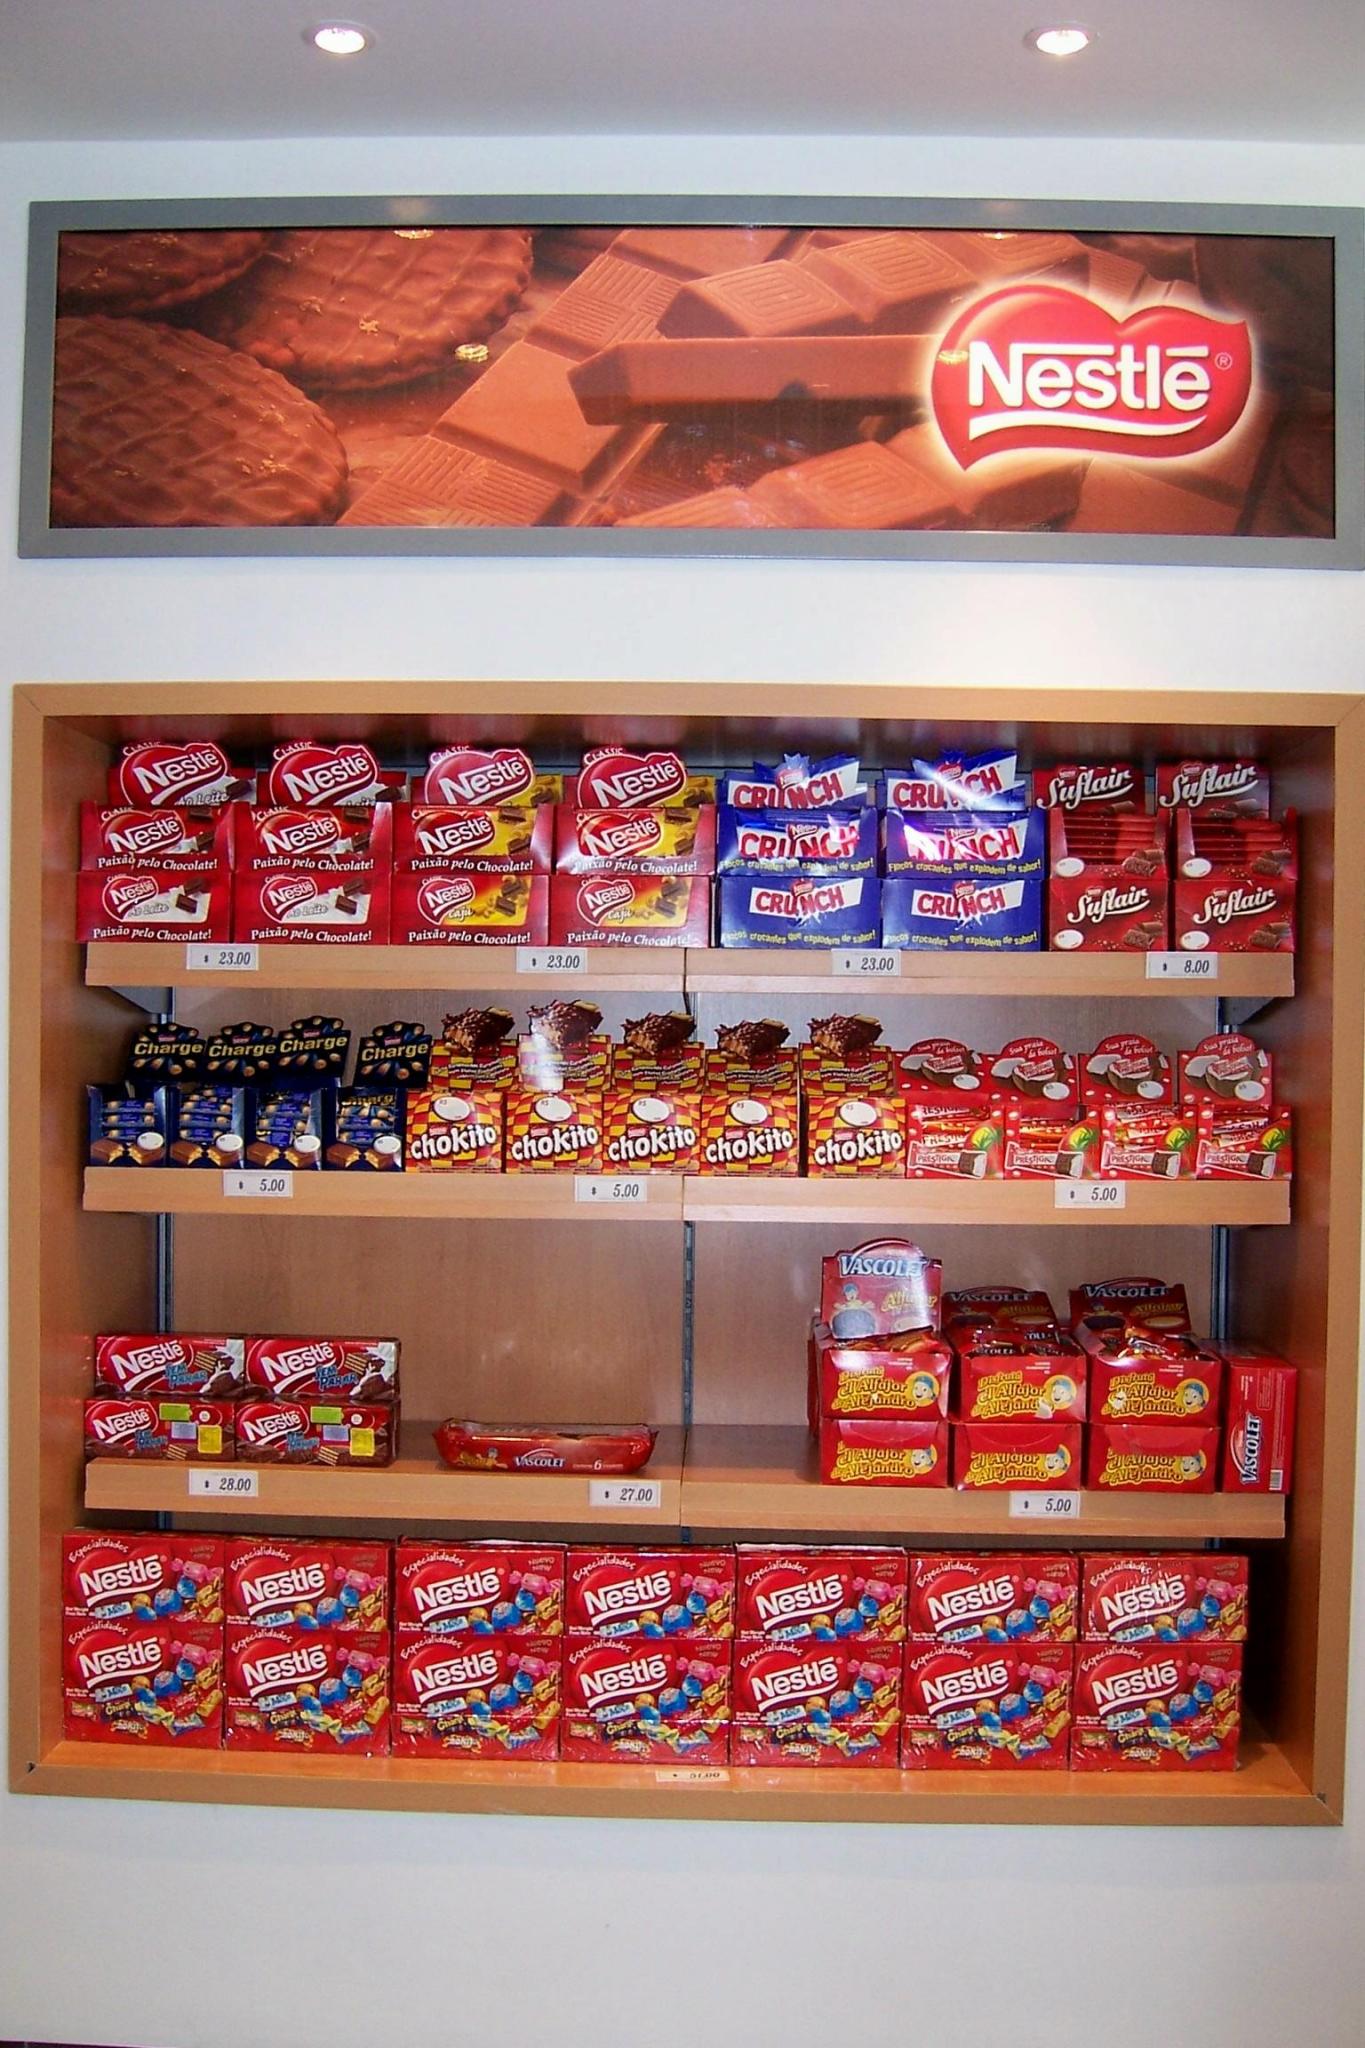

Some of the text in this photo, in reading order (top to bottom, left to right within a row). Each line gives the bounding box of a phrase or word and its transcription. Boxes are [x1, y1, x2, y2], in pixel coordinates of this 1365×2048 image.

[733, 772, 844, 809] CRUNCH
[893, 766, 1003, 809] CRUCH
[1037, 767, 1132, 811] Suflair
[1159, 764, 1258, 808] Suflair
[137, 856, 161, 869] pelo
[162, 859, 218, 871] Chocolate!
[292, 857, 316, 870] pelo
[317, 859, 374, 871] Chocolate!
[451, 860, 474, 870] pelo
[476, 860, 534, 873] Chocolate!
[614, 860, 638, 872] pelo
[755, 886, 844, 915] CRUNCH
[917, 888, 1006, 919] CRUNCH
[1067, 885, 1150, 923] Suflair
[1193, 886, 1275, 924] Suflair
[92, 925, 212, 941] Paixão pelo Chocolate!
[251, 926, 372, 943] Paixão pelo Chocolate!
[408, 929, 531, 945] Paixão pelo Chocolate!
[607, 932, 632, 943] pelo
[218, 951, 251, 966] 23.00
[547, 955, 580, 969] 23.00
[861, 957, 894, 971] 23.00
[1184, 959, 1210, 974] 8.00
[134, 1043, 203, 1057] Charge
[208, 1044, 277, 1058] Charge
[280, 1037, 348, 1054] Charge
[361, 1043, 429, 1062] Charge
[411, 1124, 497, 1160] chokito
[511, 1124, 599, 1161] chokito
[607, 1126, 697, 1164] chokito
[704, 1127, 794, 1165] chokito
[813, 1129, 903, 1166] chokito
[260, 1178, 286, 1193] 5.00
[613, 1183, 639, 1198] 5.00
[1091, 1187, 1117, 1201] 5.00
[594, 1459, 602, 1470] 6
[219, 1477, 251, 1491] 28.00
[620, 1488, 652, 1502] 27.00
[1046, 1498, 1071, 1512] 5.00
